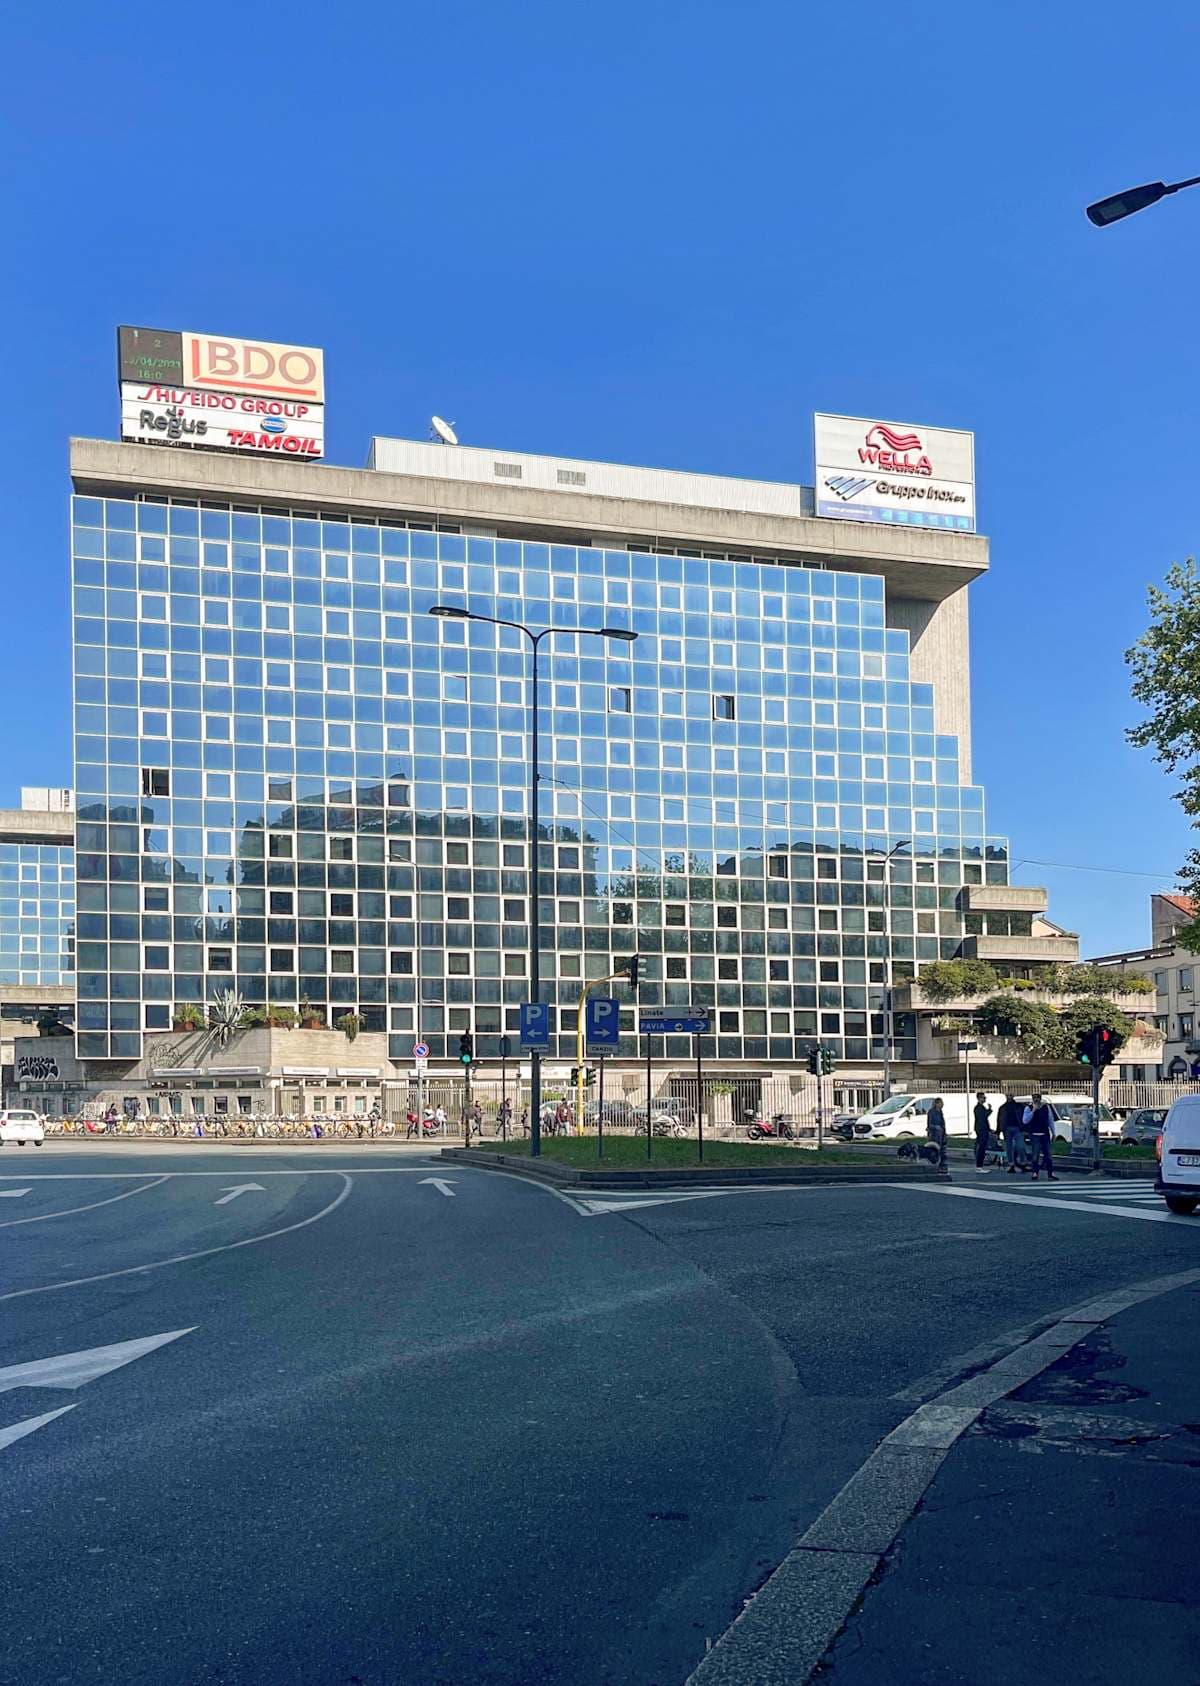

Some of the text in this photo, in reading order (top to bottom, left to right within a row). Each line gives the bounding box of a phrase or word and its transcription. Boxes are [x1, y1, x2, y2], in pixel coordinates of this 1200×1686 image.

[207, 340, 317, 386] BDO
[137, 385, 310, 419] SHISEIDO GROUP
[139, 409, 208, 440] Regus
[227, 429, 322, 455] TAMOIL
[858, 448, 933, 468] WELLA
[876, 480, 926, 501] Gruppo
[927, 486, 955, 503] Inox
[526, 1006, 543, 1025] P
[594, 1001, 613, 1023] P
[640, 1009, 664, 1017] Linate
[640, 1022, 665, 1031] PAVIA
